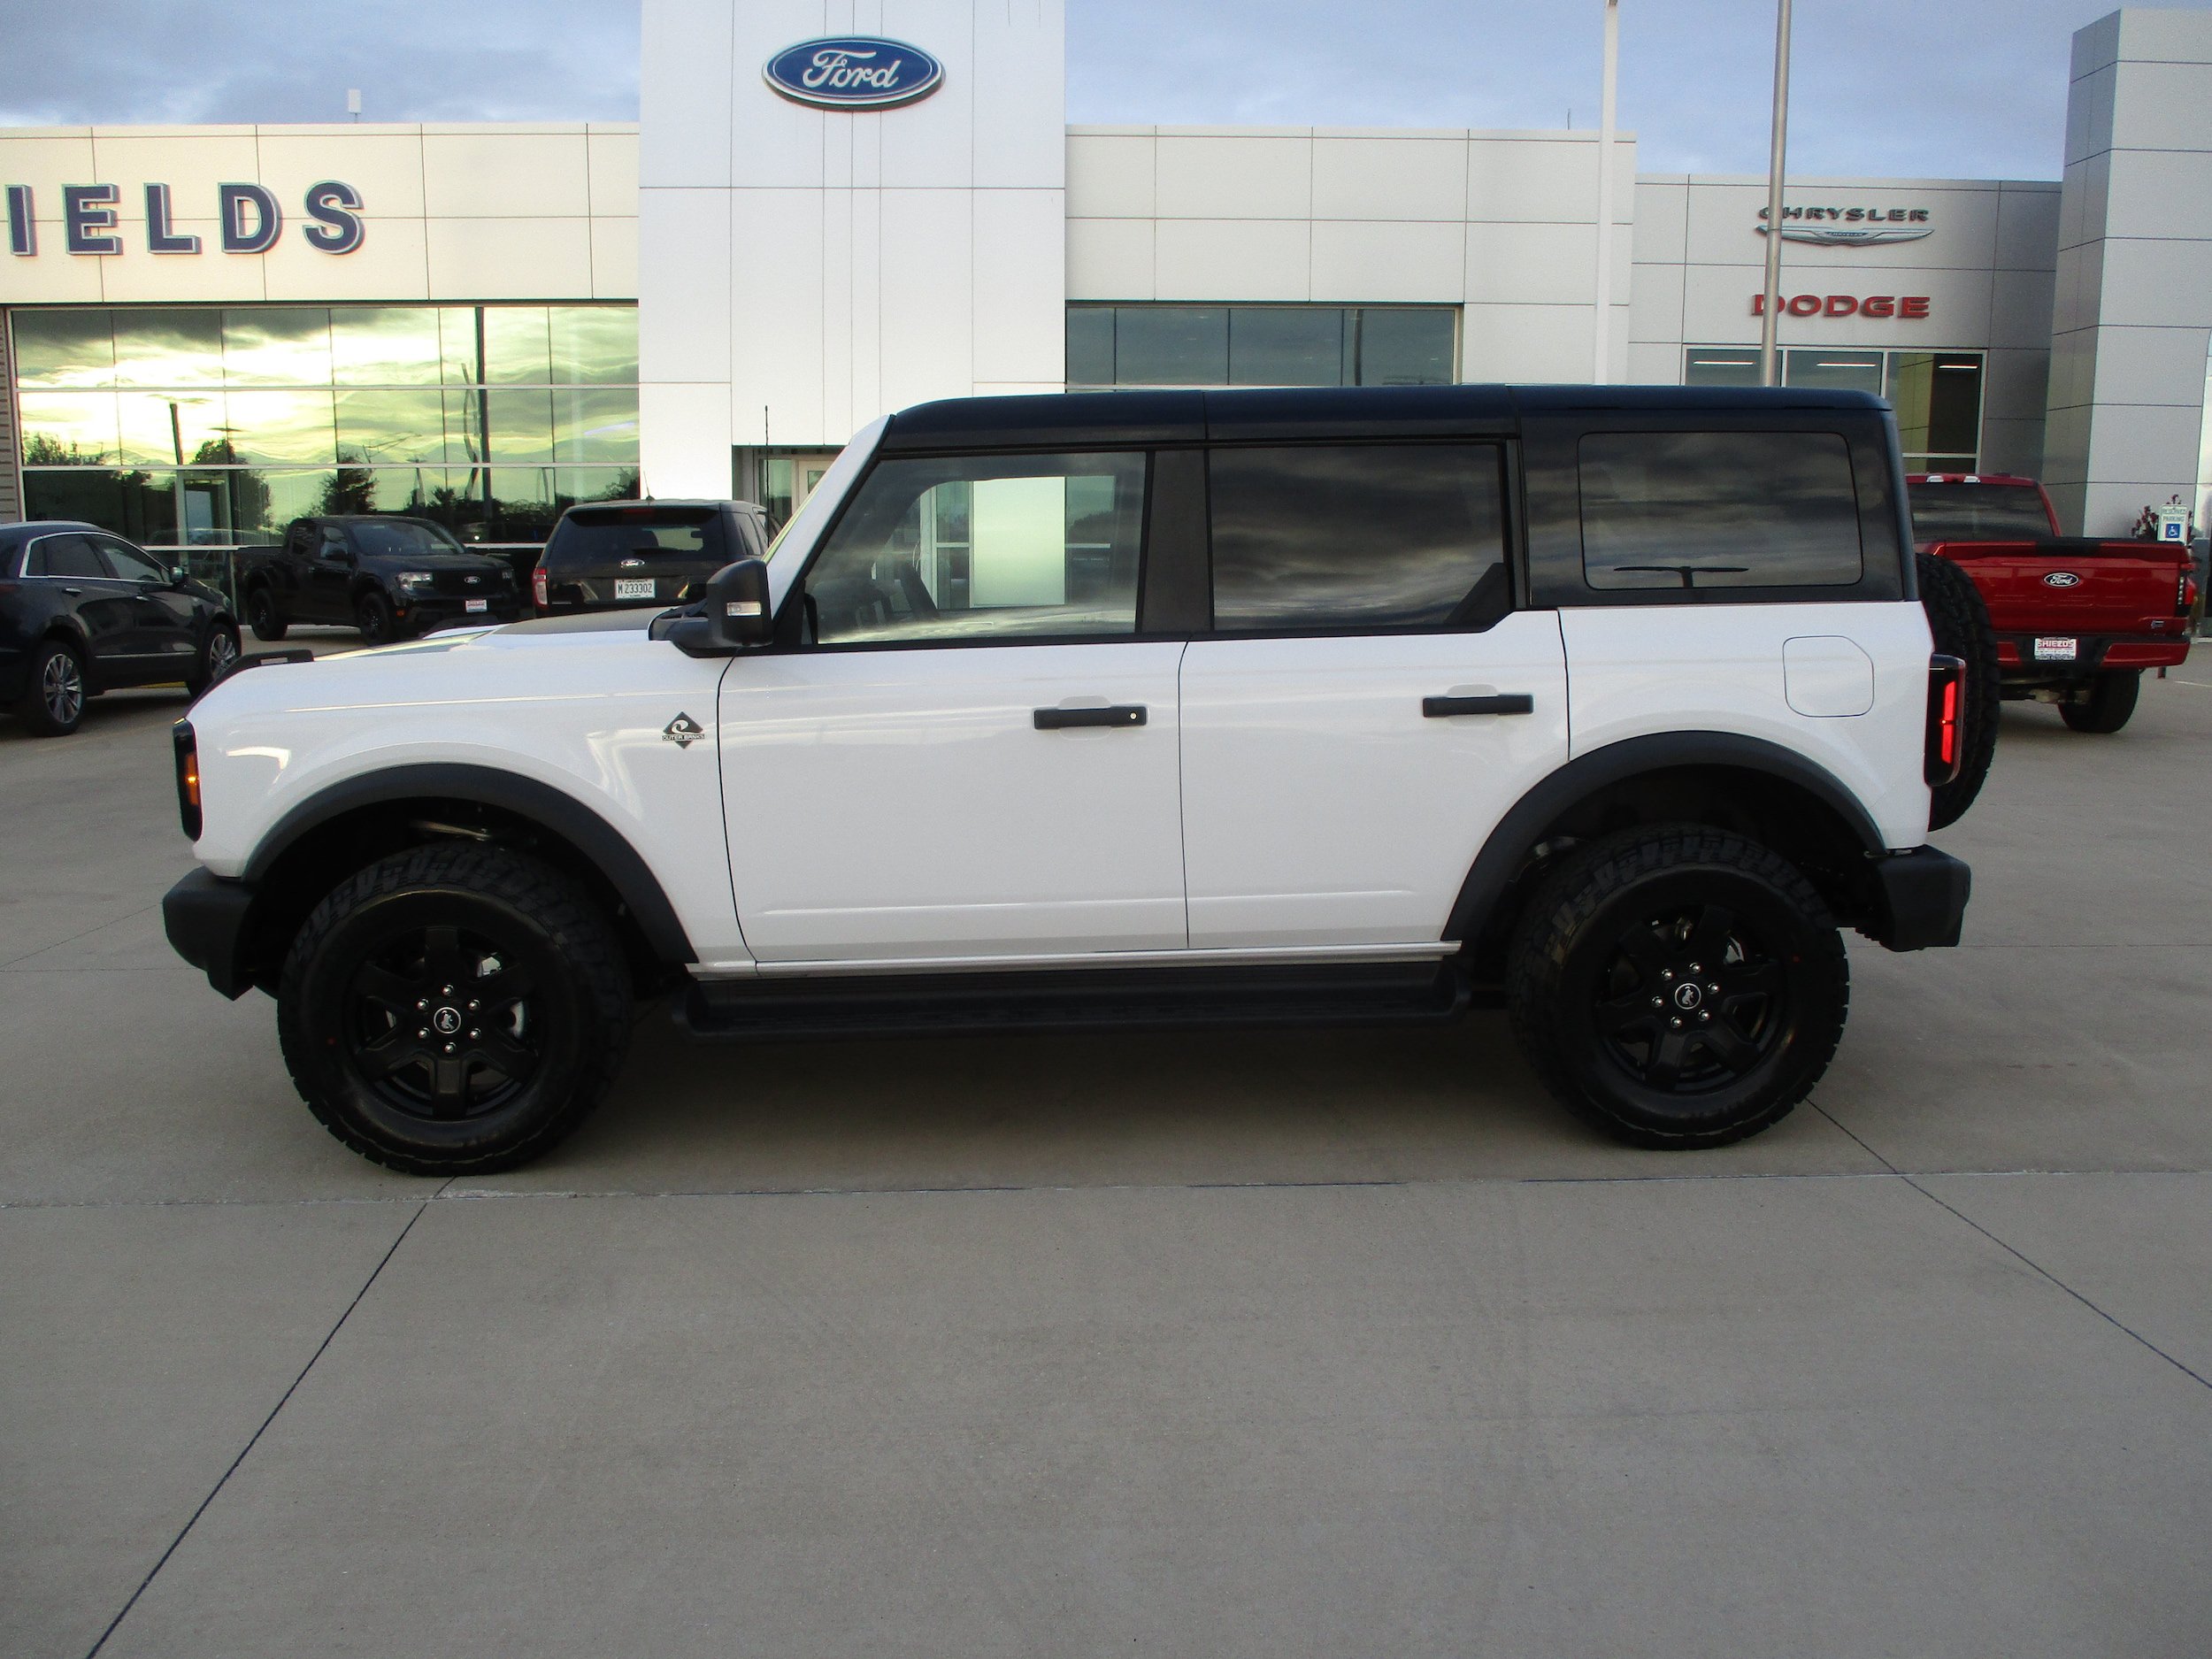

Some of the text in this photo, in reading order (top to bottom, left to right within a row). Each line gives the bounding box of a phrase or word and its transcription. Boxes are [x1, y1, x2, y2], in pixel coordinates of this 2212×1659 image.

[802, 49, 901, 88] Ford
[4, 180, 365, 256] IELDS
[1751, 294, 1931, 319] DODGE
[625, 583, 653, 594] 233302
[2050, 575, 2073, 584] Ford
